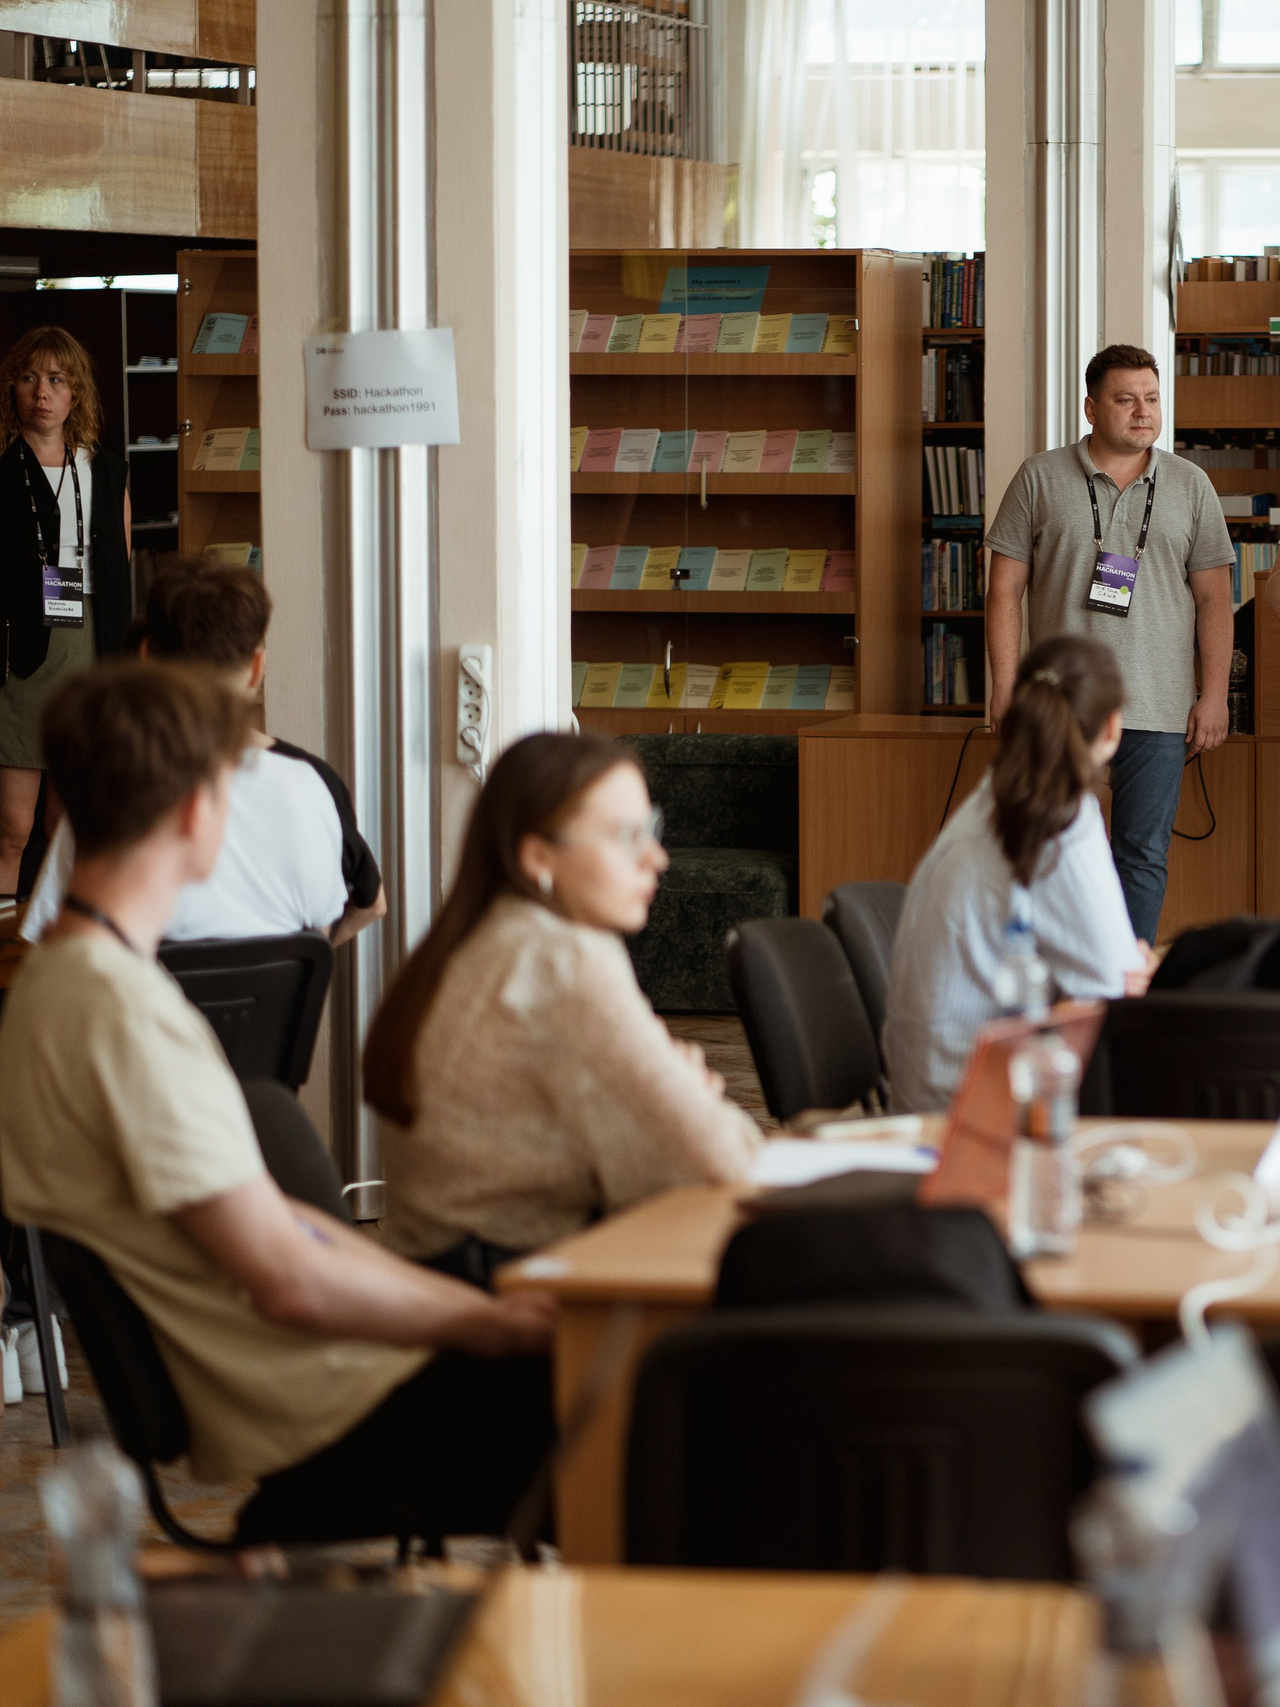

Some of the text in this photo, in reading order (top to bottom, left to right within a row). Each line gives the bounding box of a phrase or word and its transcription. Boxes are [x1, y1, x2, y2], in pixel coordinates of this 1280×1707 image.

[333, 386, 423, 400] SSID: Hackathon
[323, 402, 436, 416] Pass: hackathon1991
[1097, 566, 1135, 578] HACKATHON
